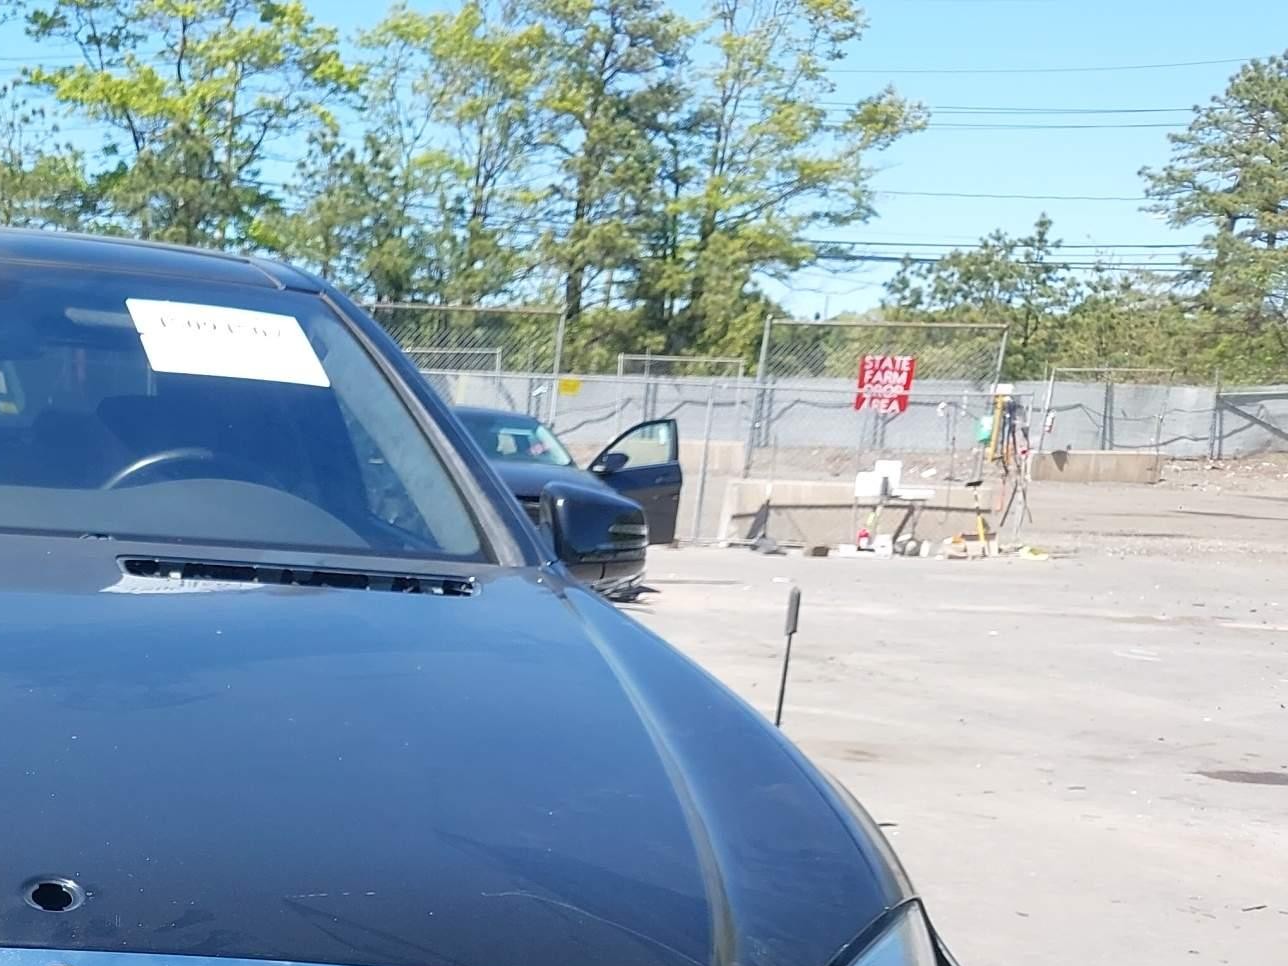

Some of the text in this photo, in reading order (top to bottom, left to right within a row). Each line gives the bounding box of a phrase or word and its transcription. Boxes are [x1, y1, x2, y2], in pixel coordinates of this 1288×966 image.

[864, 355, 912, 371] STATE
[863, 370, 908, 385] FARM
[861, 397, 901, 414] AREA
